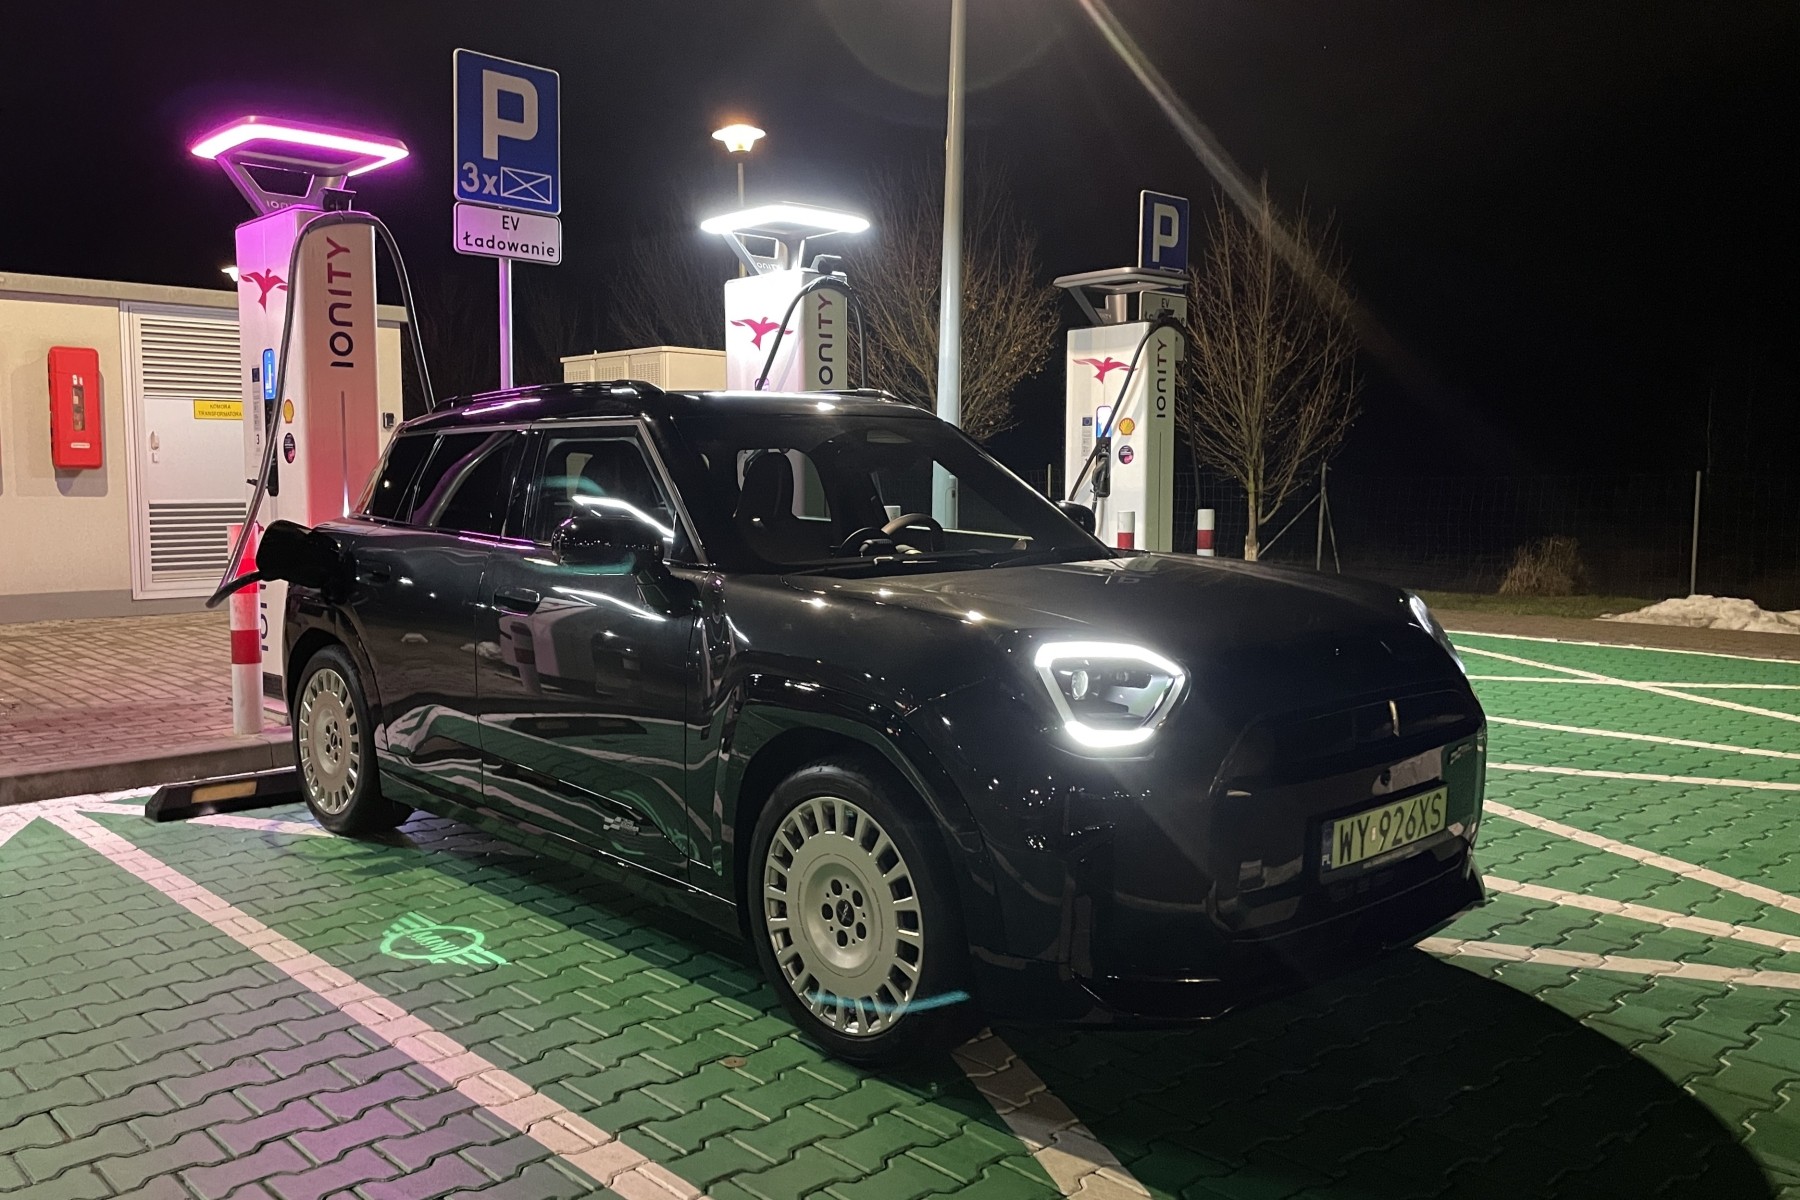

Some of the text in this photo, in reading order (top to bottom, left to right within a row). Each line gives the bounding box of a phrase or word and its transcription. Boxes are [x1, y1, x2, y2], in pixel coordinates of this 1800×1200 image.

[483, 69, 539, 160] P
[461, 162, 498, 196] 3x
[463, 231, 555, 257] Ładowanie
[502, 215, 520, 231] EV
[1152, 202, 1180, 263] P
[326, 236, 354, 368] IONITY
[1161, 297, 1170, 308] EV
[818, 292, 834, 390] ONITY
[1157, 338, 1168, 419] IONITY
[1339, 815, 1371, 865] WY
[1378, 792, 1442, 851] 926XS
